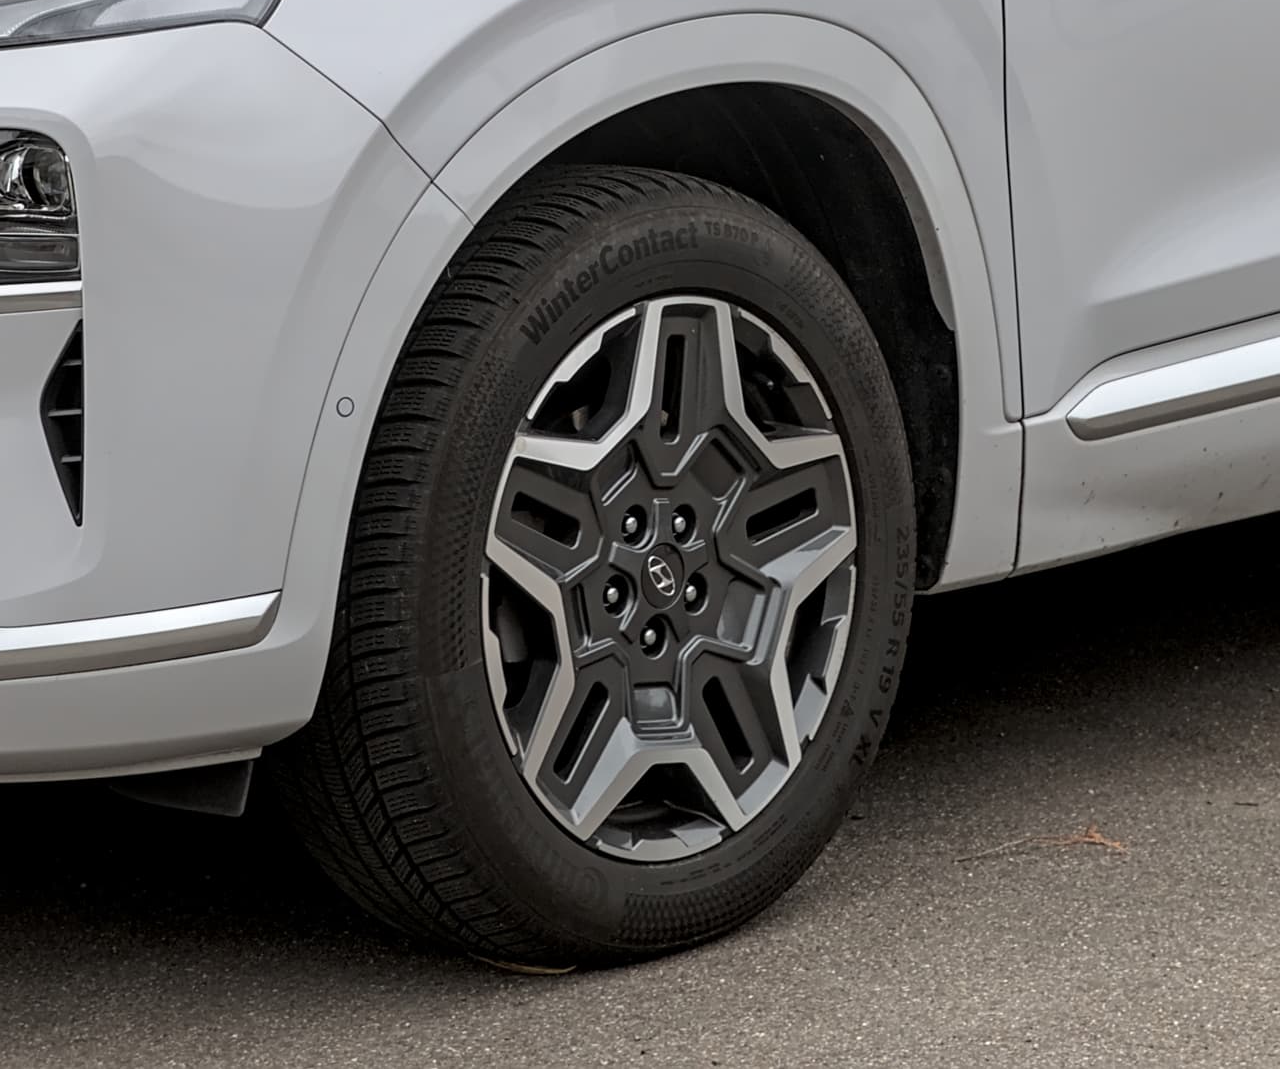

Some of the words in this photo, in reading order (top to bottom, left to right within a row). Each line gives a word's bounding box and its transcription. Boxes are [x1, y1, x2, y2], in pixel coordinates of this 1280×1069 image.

[520, 222, 699, 345] WinterContact
[704, 220, 722, 236] TS
[890, 524, 911, 628] 235/55
[884, 637, 901, 657] R
[878, 665, 895, 694] 19
[869, 708, 884, 729] V
